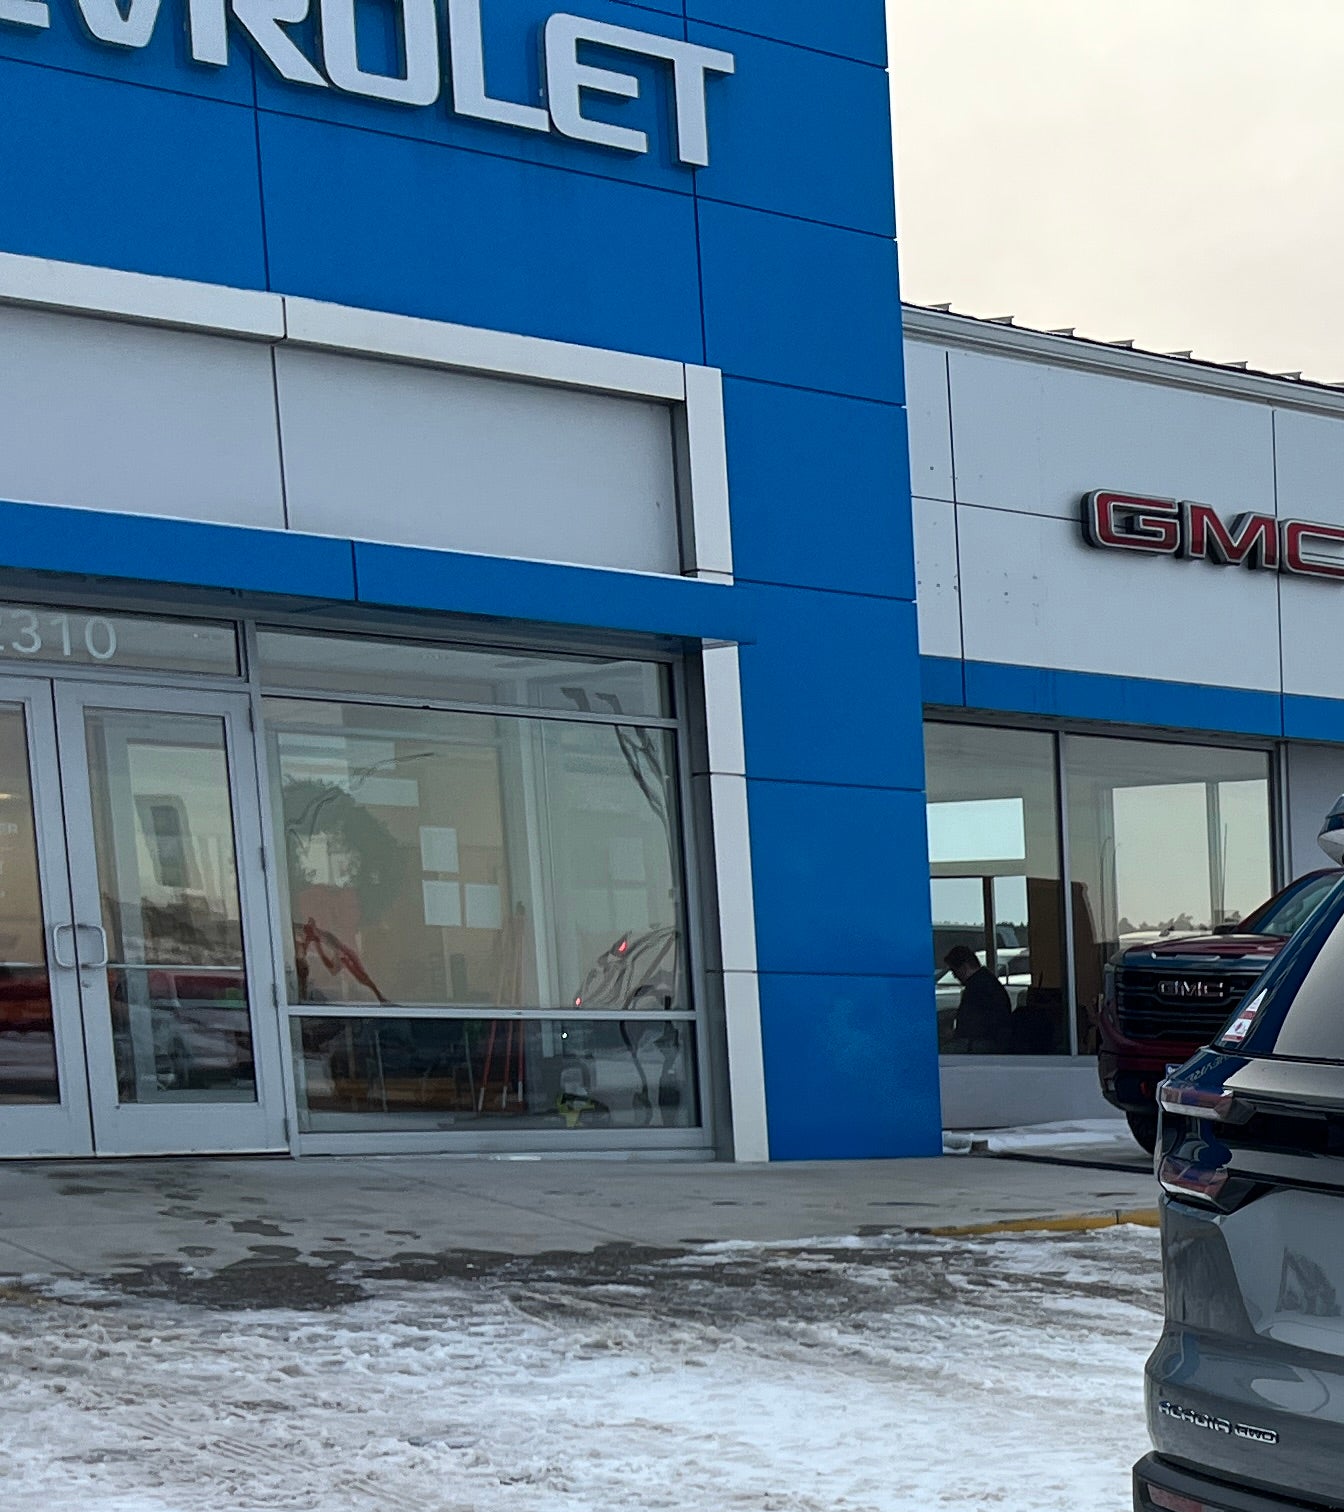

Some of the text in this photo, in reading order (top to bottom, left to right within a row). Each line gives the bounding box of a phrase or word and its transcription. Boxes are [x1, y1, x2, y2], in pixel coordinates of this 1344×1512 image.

[0, 0, 735, 166] ROLET
[0, 609, 117, 659] 310
[1158, 980, 1223, 997] GMC
